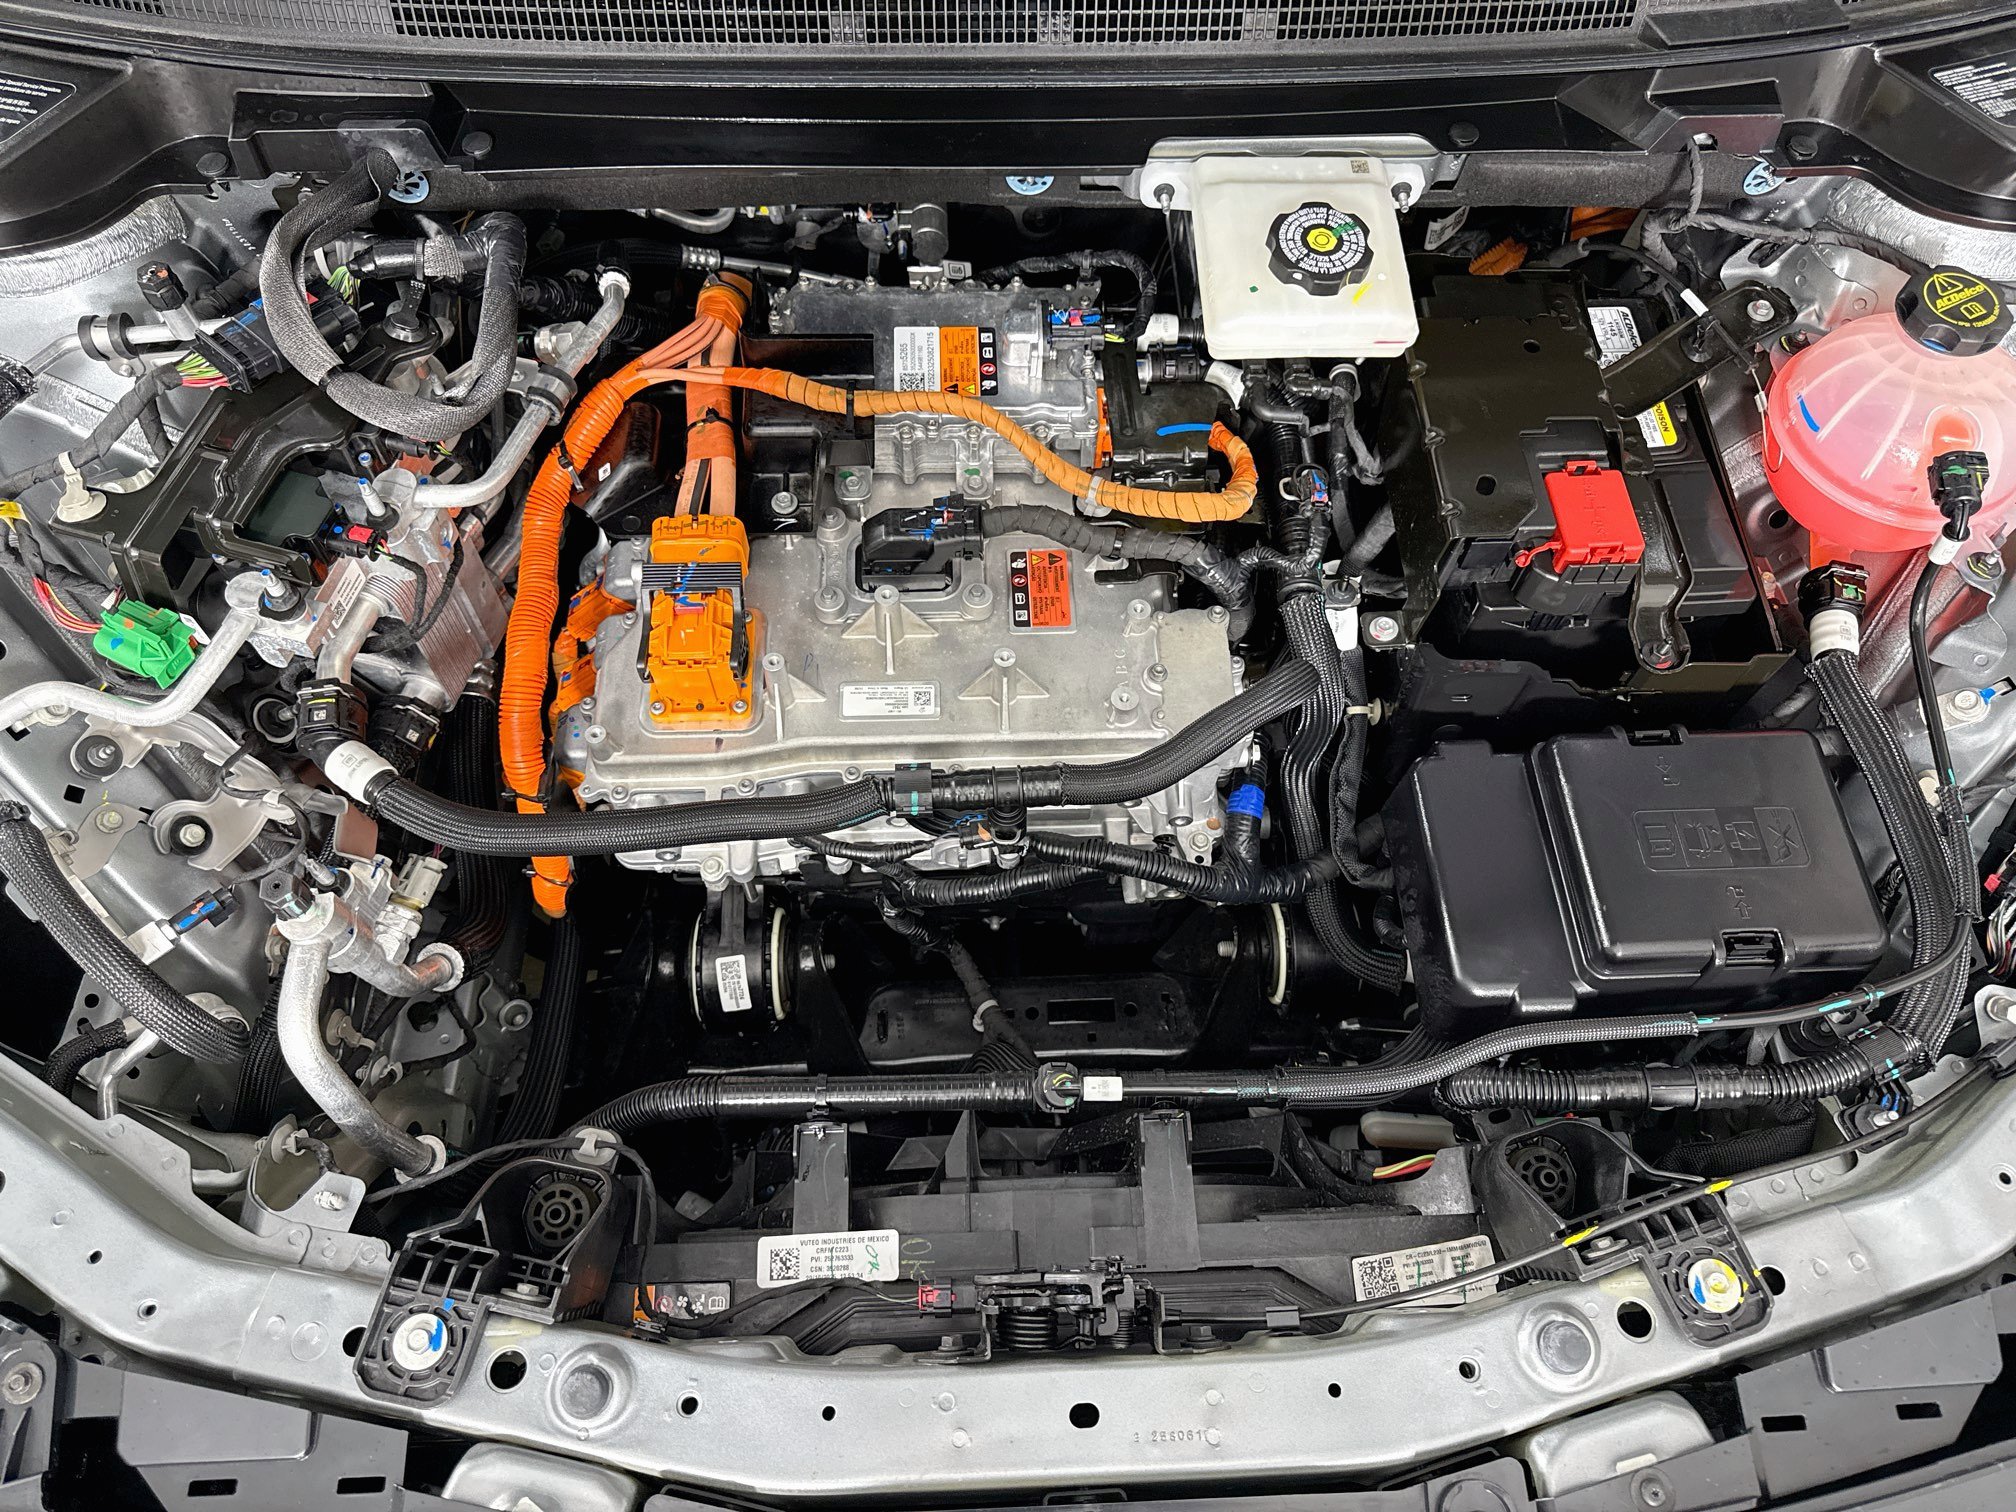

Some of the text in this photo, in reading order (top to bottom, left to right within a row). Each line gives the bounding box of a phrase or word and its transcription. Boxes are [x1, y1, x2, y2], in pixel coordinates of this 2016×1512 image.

[1936, 284, 1985, 309] ACDelco
[1607, 321, 1617, 337] 1145
[1620, 310, 1640, 348] ACDelco
